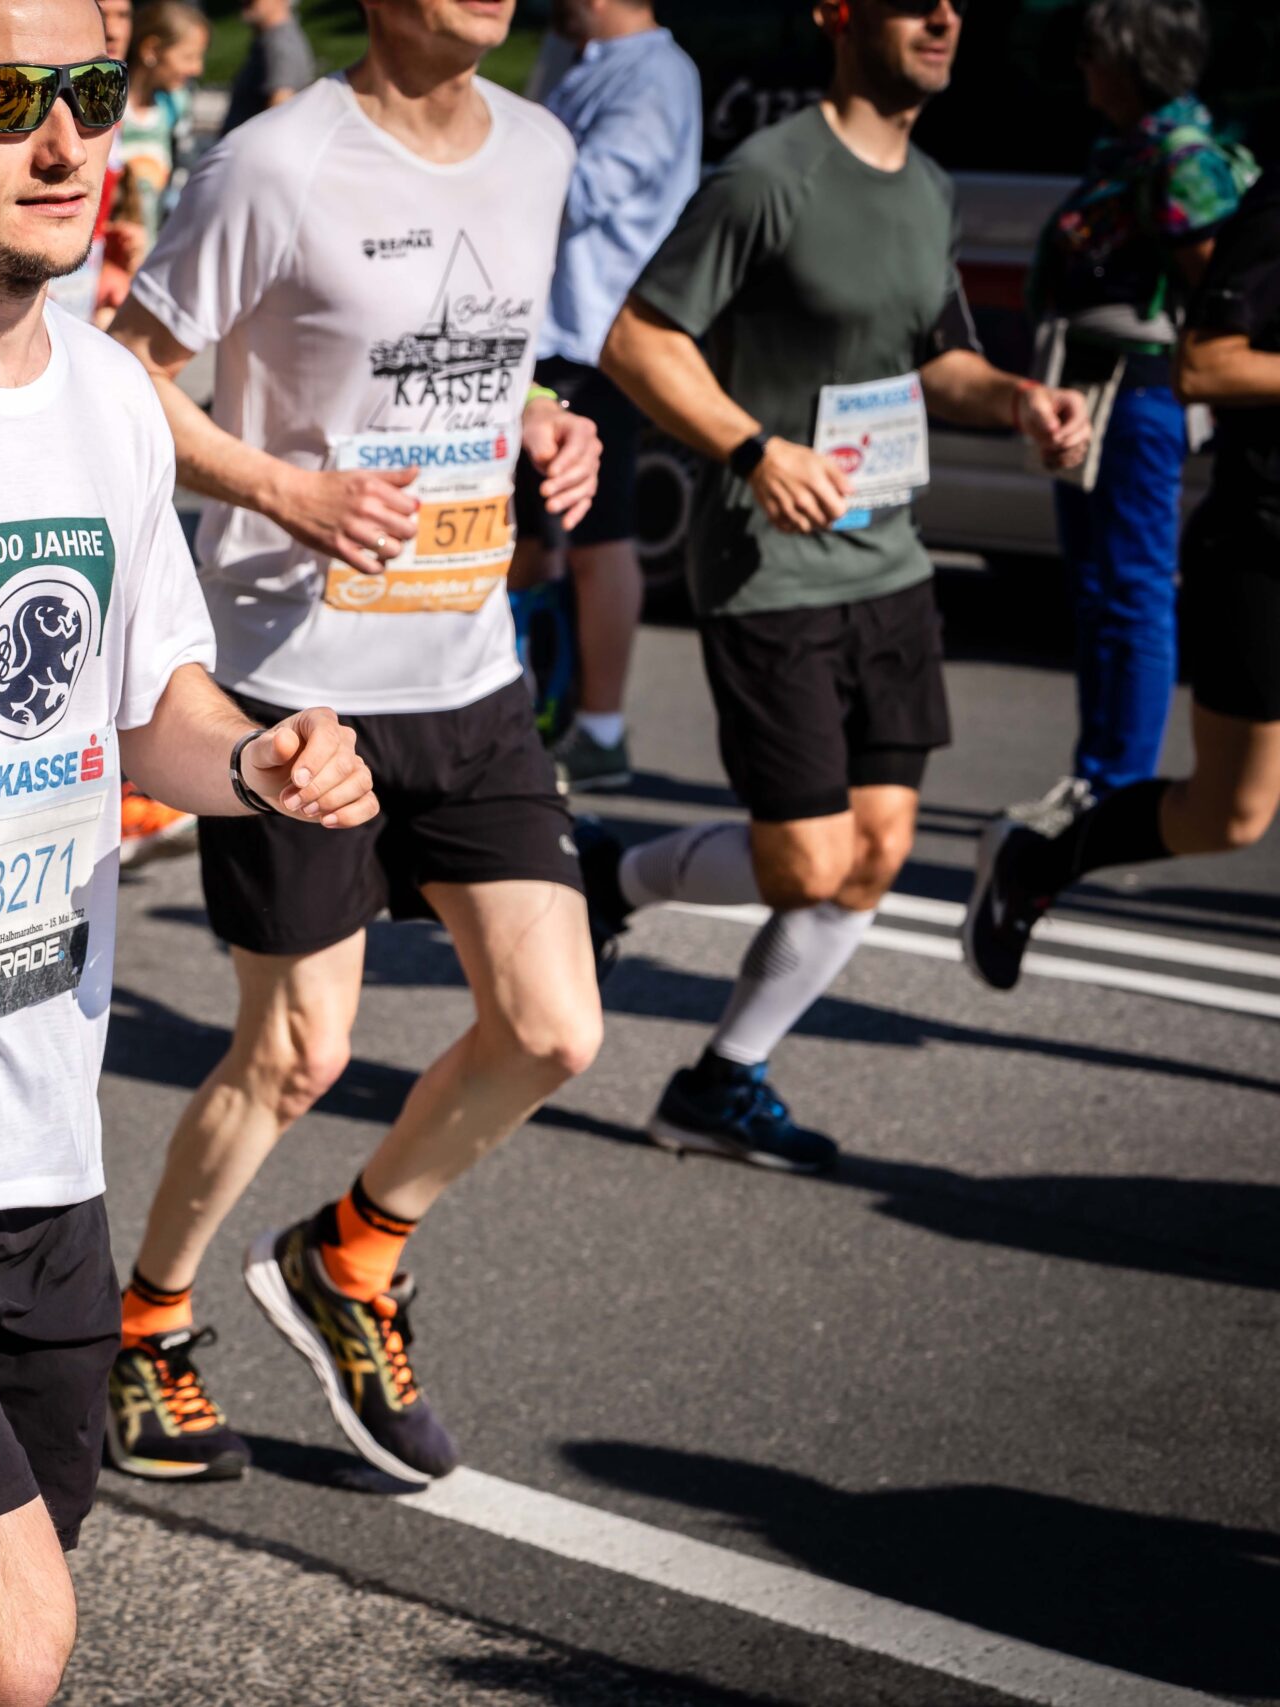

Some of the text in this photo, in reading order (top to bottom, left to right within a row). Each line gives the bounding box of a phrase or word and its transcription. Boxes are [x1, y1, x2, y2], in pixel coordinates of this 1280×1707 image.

[358, 439, 492, 469] SPARKASSE
[31, 530, 105, 559] JAHRE
[0, 922, 44, 944] Halbmarathon
[49, 918, 58, 928] 15.
[58, 914, 70, 926] Mai
